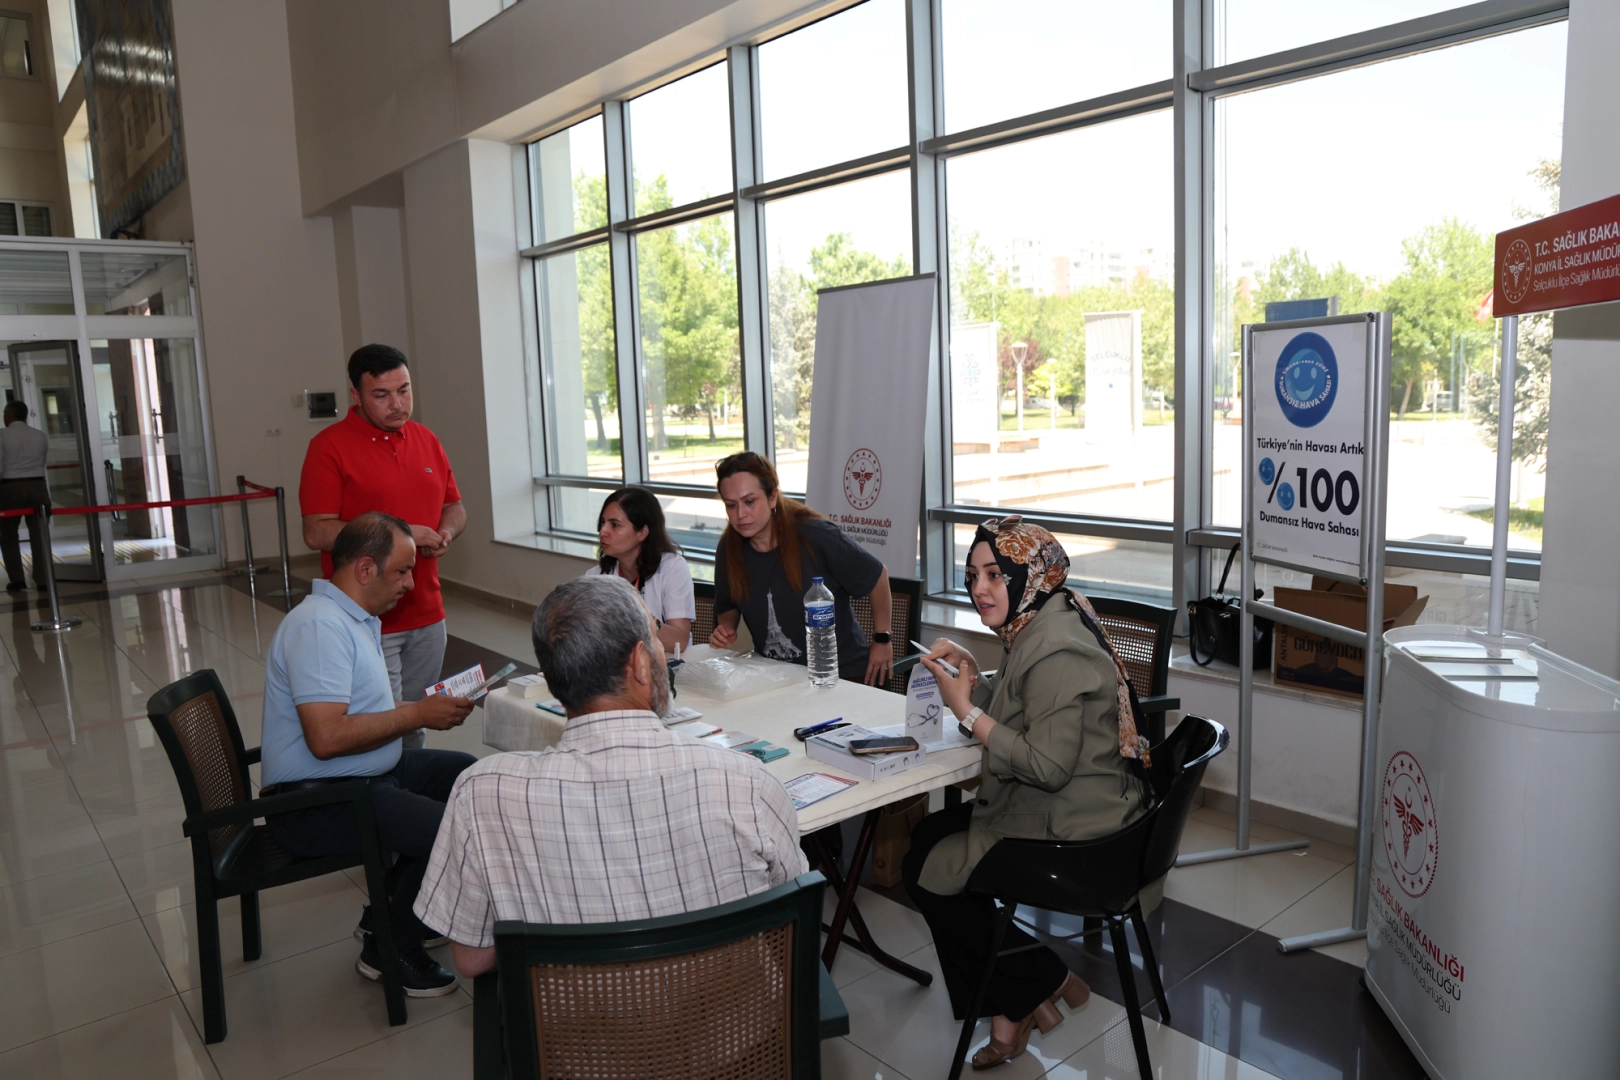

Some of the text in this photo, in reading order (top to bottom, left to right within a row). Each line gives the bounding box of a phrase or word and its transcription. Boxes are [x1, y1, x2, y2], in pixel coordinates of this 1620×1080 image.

[1534, 222, 1620, 257] T.C. SAĞLIK BAKA
[1534, 259, 1556, 275] KONYA
[1557, 256, 1564, 271] İL
[1564, 250, 1591, 269] SAĞLIK
[1533, 276, 1558, 293] Selçuklu
[1558, 273, 1570, 290] İlçe
[1570, 269, 1591, 286] Sağlık
[1279, 379, 1332, 409] DUMANSIZ HAVA SAHASI
[1305, 440, 1337, 454] Havası
[1340, 442, 1364, 455] Artık
[840, 514, 861, 524] SAĞLIK
[861, 517, 892, 529] BAKANLIĞI
[861, 527, 888, 537] MÜDÜRLÜĞÜ
[1260, 511, 1359, 537] Dumansız Hava Sahası
[1376, 877, 1403, 922] SAĞLIK
[1404, 911, 1464, 982] BAKANLIĞI
[1385, 911, 1406, 944] SAĞLIK
[1406, 937, 1461, 1001] MÜDÜRLÜĞÜ
[1411, 964, 1451, 1014] Müdürlüğü
